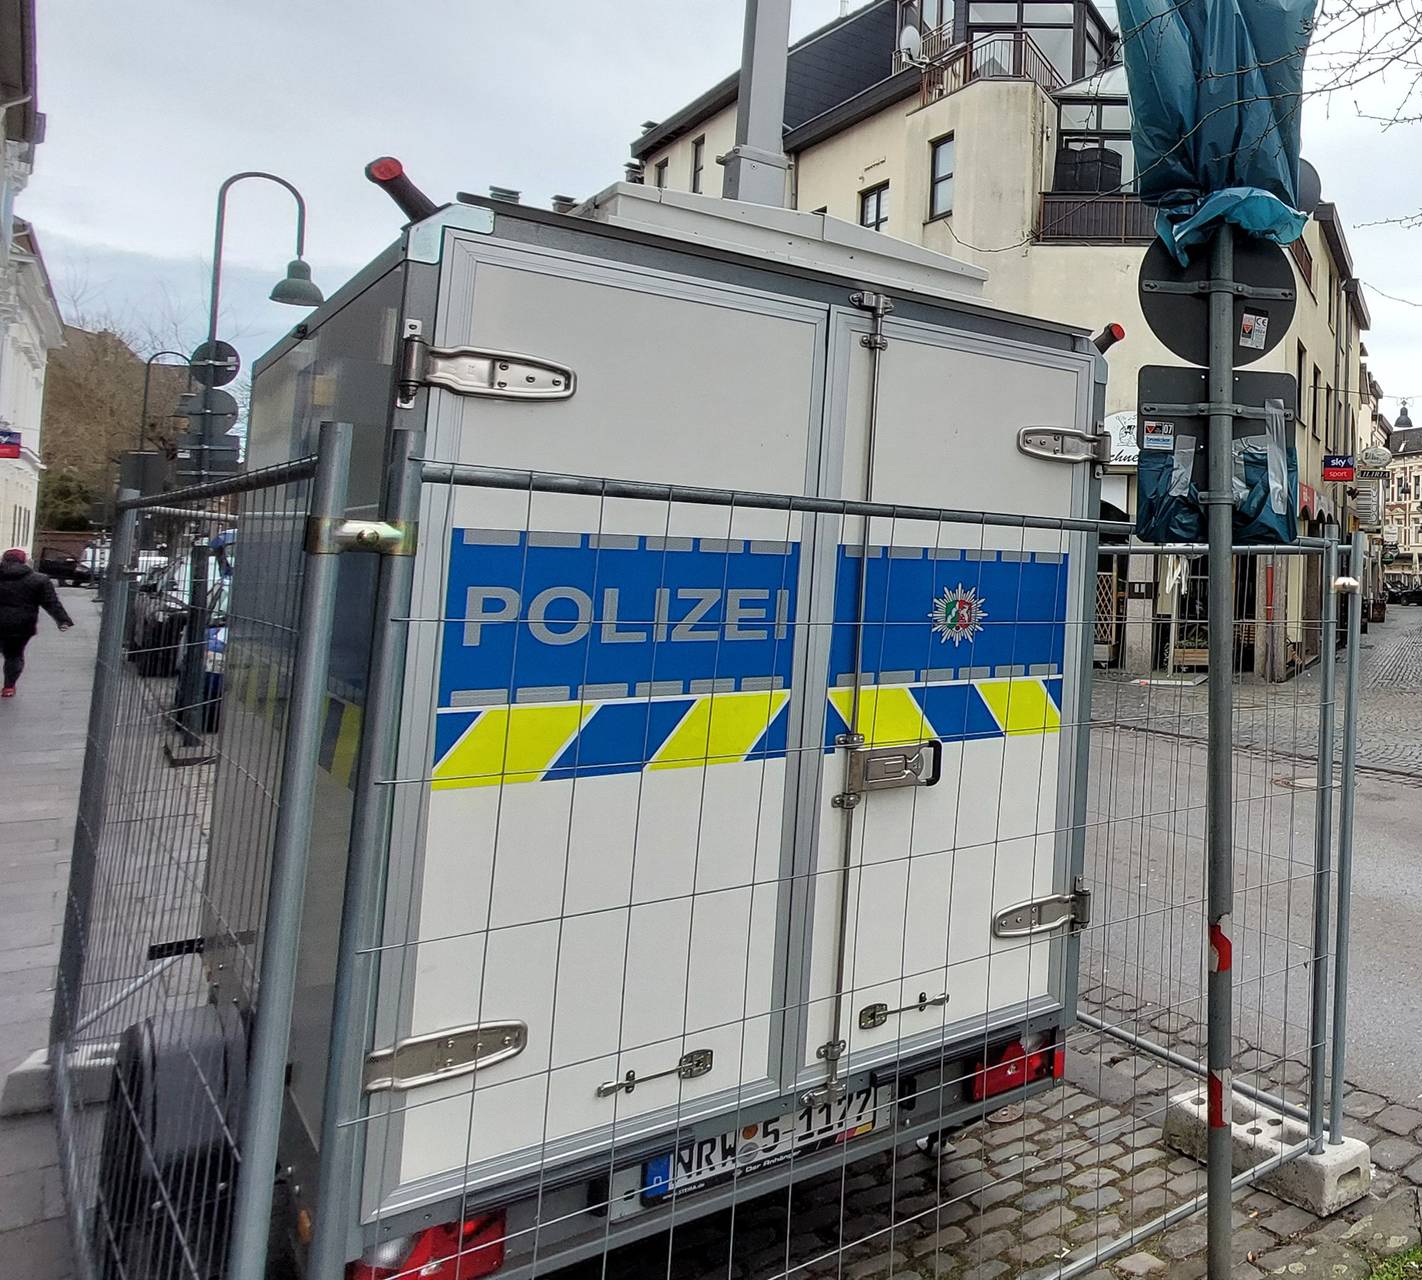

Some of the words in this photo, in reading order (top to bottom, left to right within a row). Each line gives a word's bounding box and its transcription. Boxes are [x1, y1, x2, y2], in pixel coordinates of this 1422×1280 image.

[1330, 458, 1347, 468] sky
[462, 585, 790, 647] POLIZEI
[677, 1134, 738, 1181] NRW
[745, 1161, 762, 1174] Der
